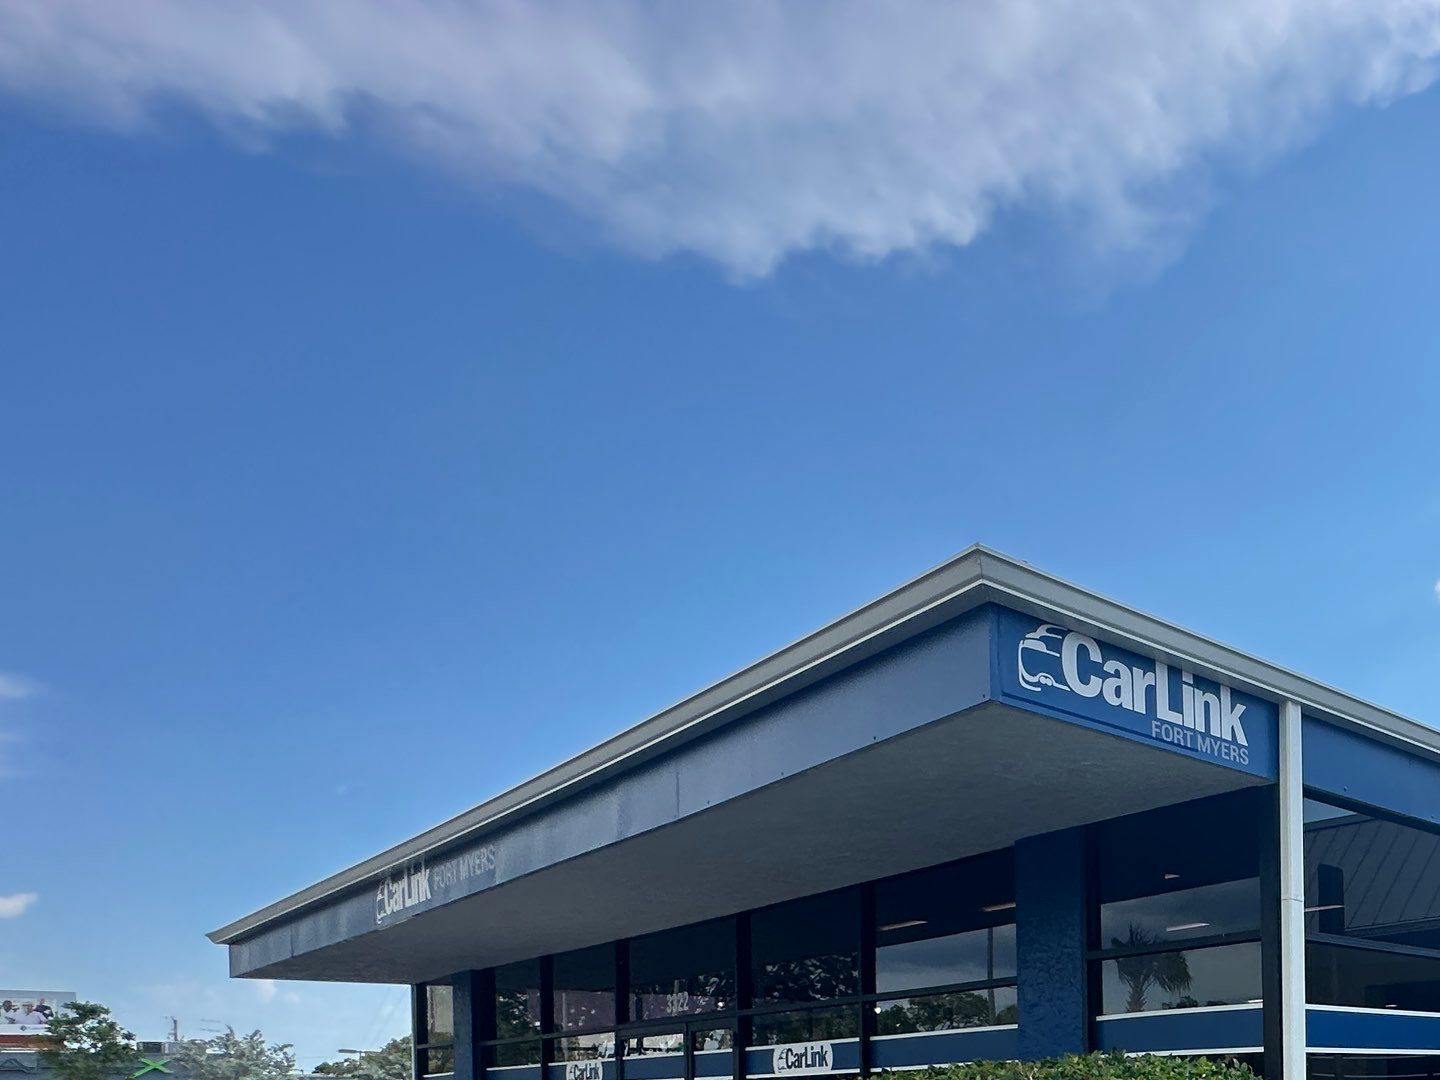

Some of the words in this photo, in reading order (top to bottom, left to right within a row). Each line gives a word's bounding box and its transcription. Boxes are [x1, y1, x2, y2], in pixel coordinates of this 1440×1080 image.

[1061, 631, 1248, 746] CarLink
[1152, 720, 1195, 749] FORT
[1198, 733, 1249, 765] MYERS
[433, 859, 457, 890] FORT
[460, 844, 496, 881] MYERS
[573, 1062, 600, 1080] CarLink
[785, 1045, 829, 1069] CarLink
